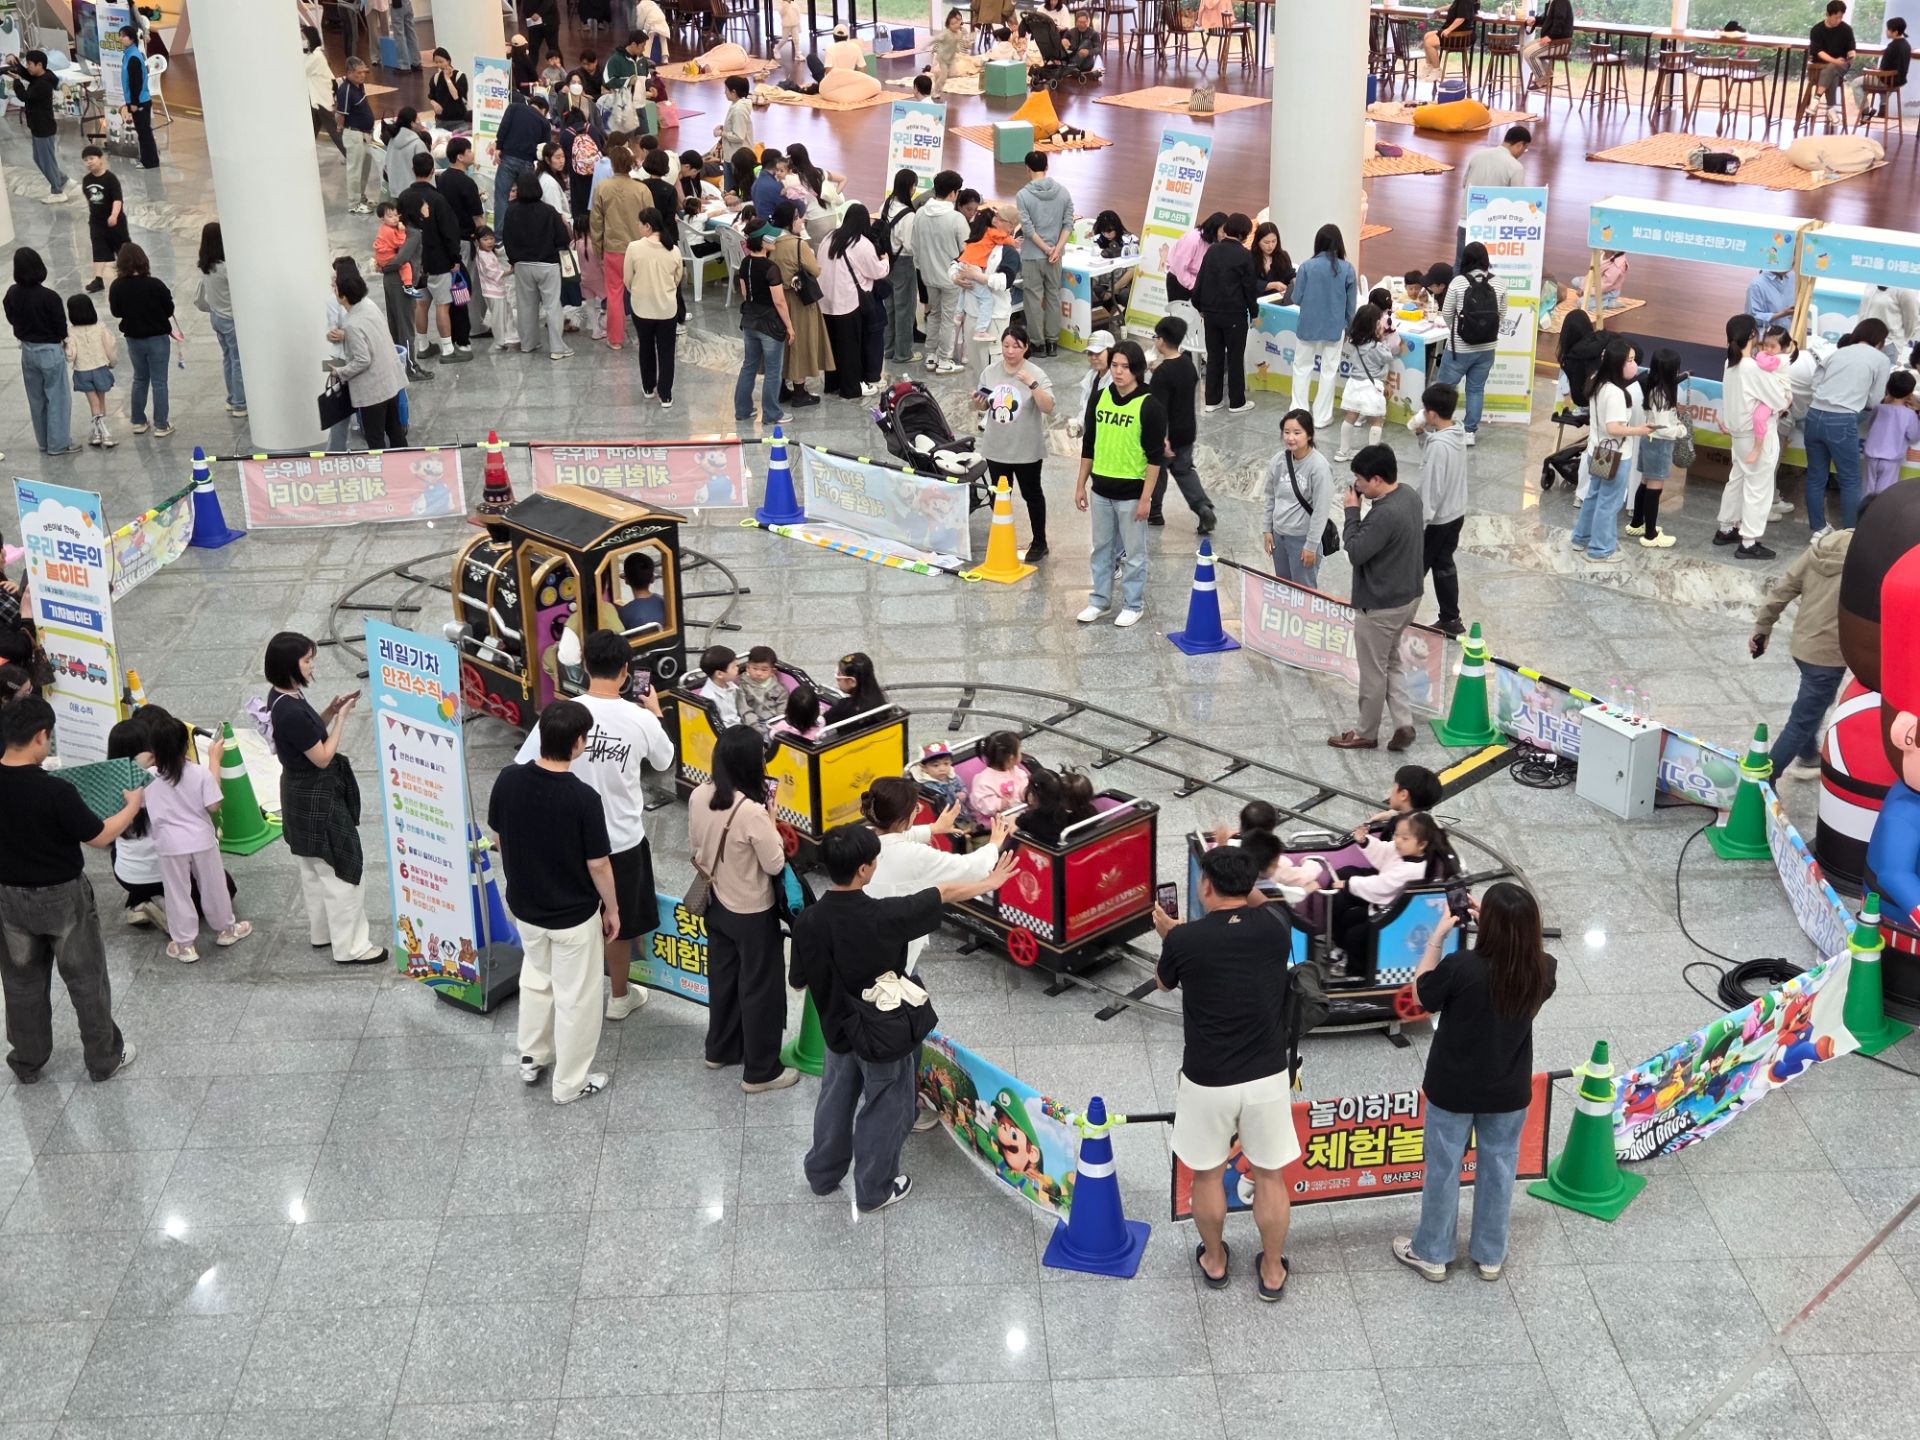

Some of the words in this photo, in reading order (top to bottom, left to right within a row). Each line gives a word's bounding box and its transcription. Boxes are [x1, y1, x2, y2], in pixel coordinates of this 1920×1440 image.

[893, 132, 912, 146] 우리
[913, 133, 942, 148] 모두의
[903, 147, 931, 161] 놀이터
[1158, 162, 1178, 178] 우리
[1178, 166, 1204, 183] 모두의
[1165, 179, 1193, 195] 놀이터
[1470, 225, 1496, 240] 우리
[1499, 225, 1541, 240] 모두의
[1632, 226, 1662, 241] 빛고을
[1664, 231, 1747, 252] 아동보호전문기관
[1851, 254, 1884, 269] 빛고을
[1096, 410, 1134, 428] STAFF
[26, 533, 55, 559] 우리
[57, 539, 103, 569] 모두의
[45, 559, 90, 588] 놀이터
[48, 603, 93, 627] 기차놀이터
[379, 638, 440, 675] 레일기차
[381, 665, 443, 703] 안전수칙
[388, 741, 397, 761] 1
[389, 766, 400, 787] 2
[392, 790, 403, 811] 3
[394, 814, 405, 834] 4
[396, 835, 406, 856] 5
[399, 861, 409, 880] 6
[401, 884, 411, 904] 7
[1309, 1089, 1420, 1129] 놀이하며
[1633, 1108, 1676, 1139] SUPER
[1656, 1110, 1691, 1145] BROS.
[1302, 1125, 1425, 1172] 체험놀
[1382, 1171, 1423, 1184] 행사문의
